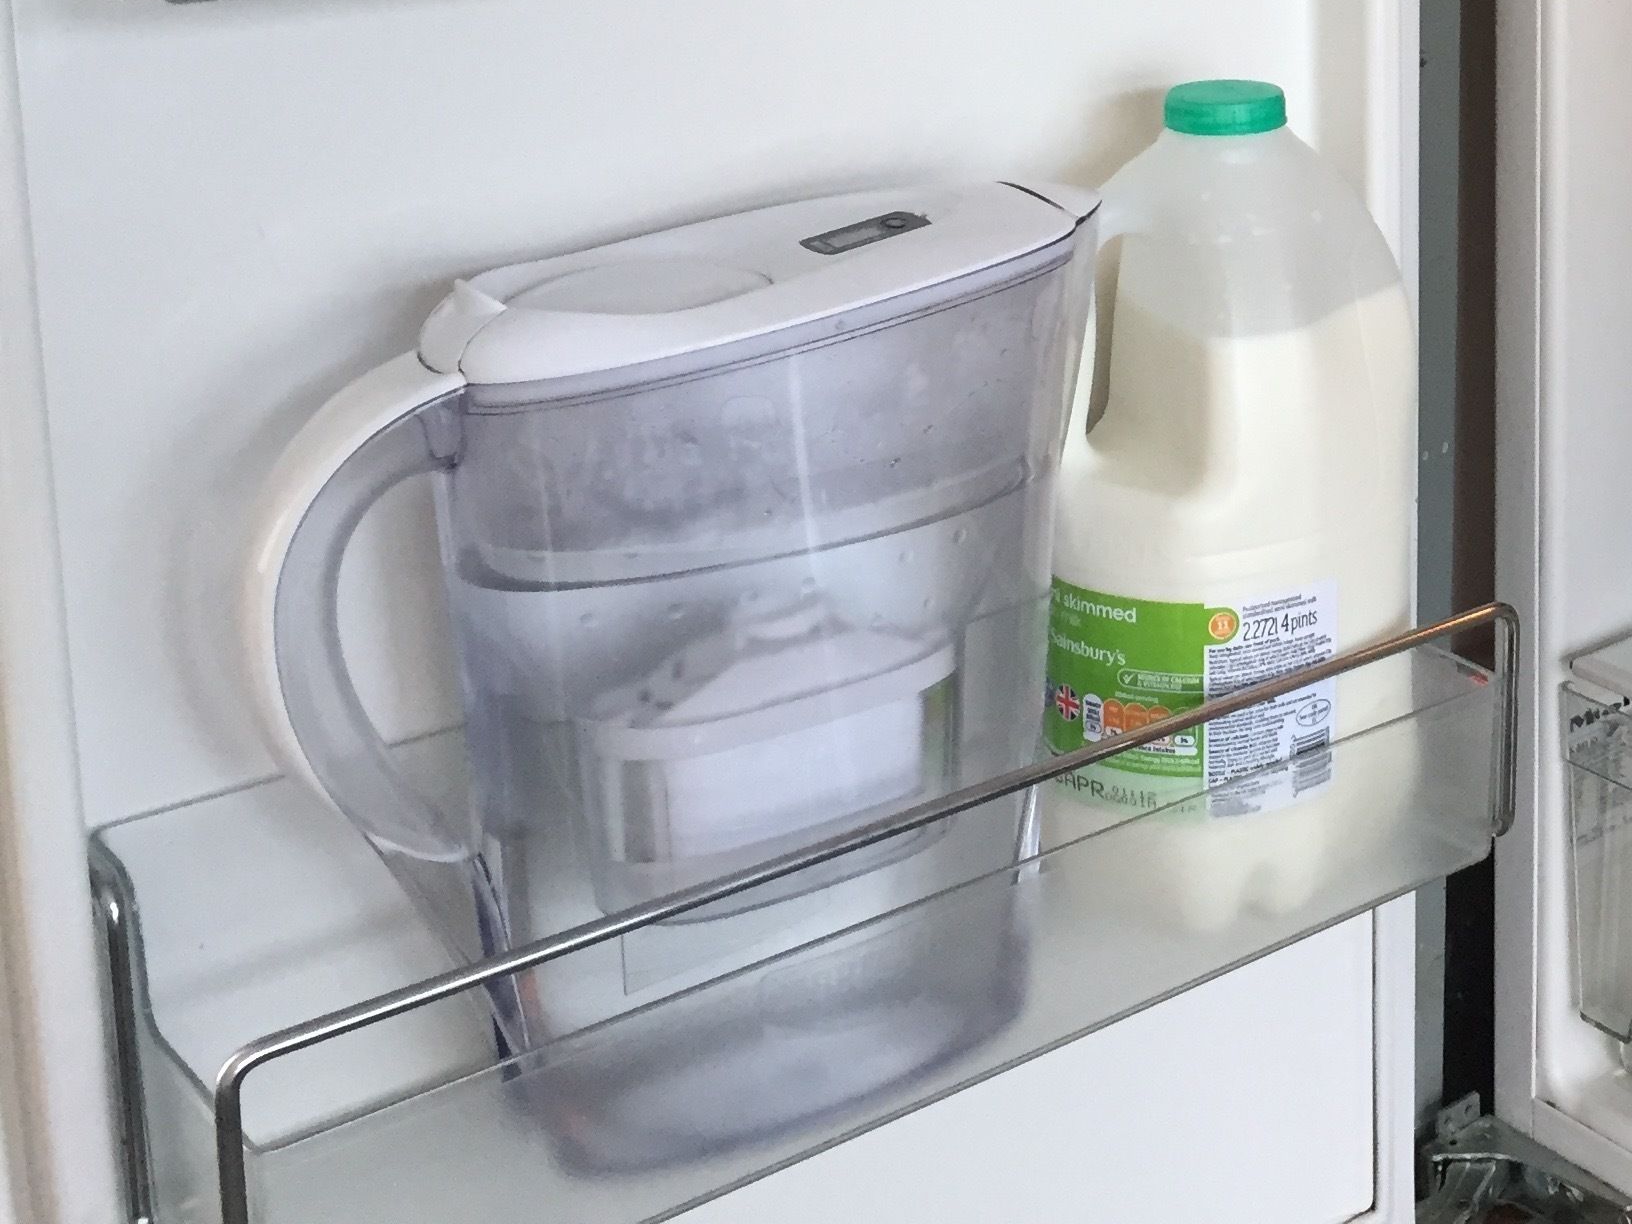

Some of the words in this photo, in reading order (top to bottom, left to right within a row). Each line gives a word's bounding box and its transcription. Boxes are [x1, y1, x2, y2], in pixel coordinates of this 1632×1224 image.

[1062, 592, 1138, 624] skimmed
[1280, 613, 1290, 632] 4
[1290, 608, 1319, 635] pints
[1048, 628, 1127, 667] Sainsbury's
